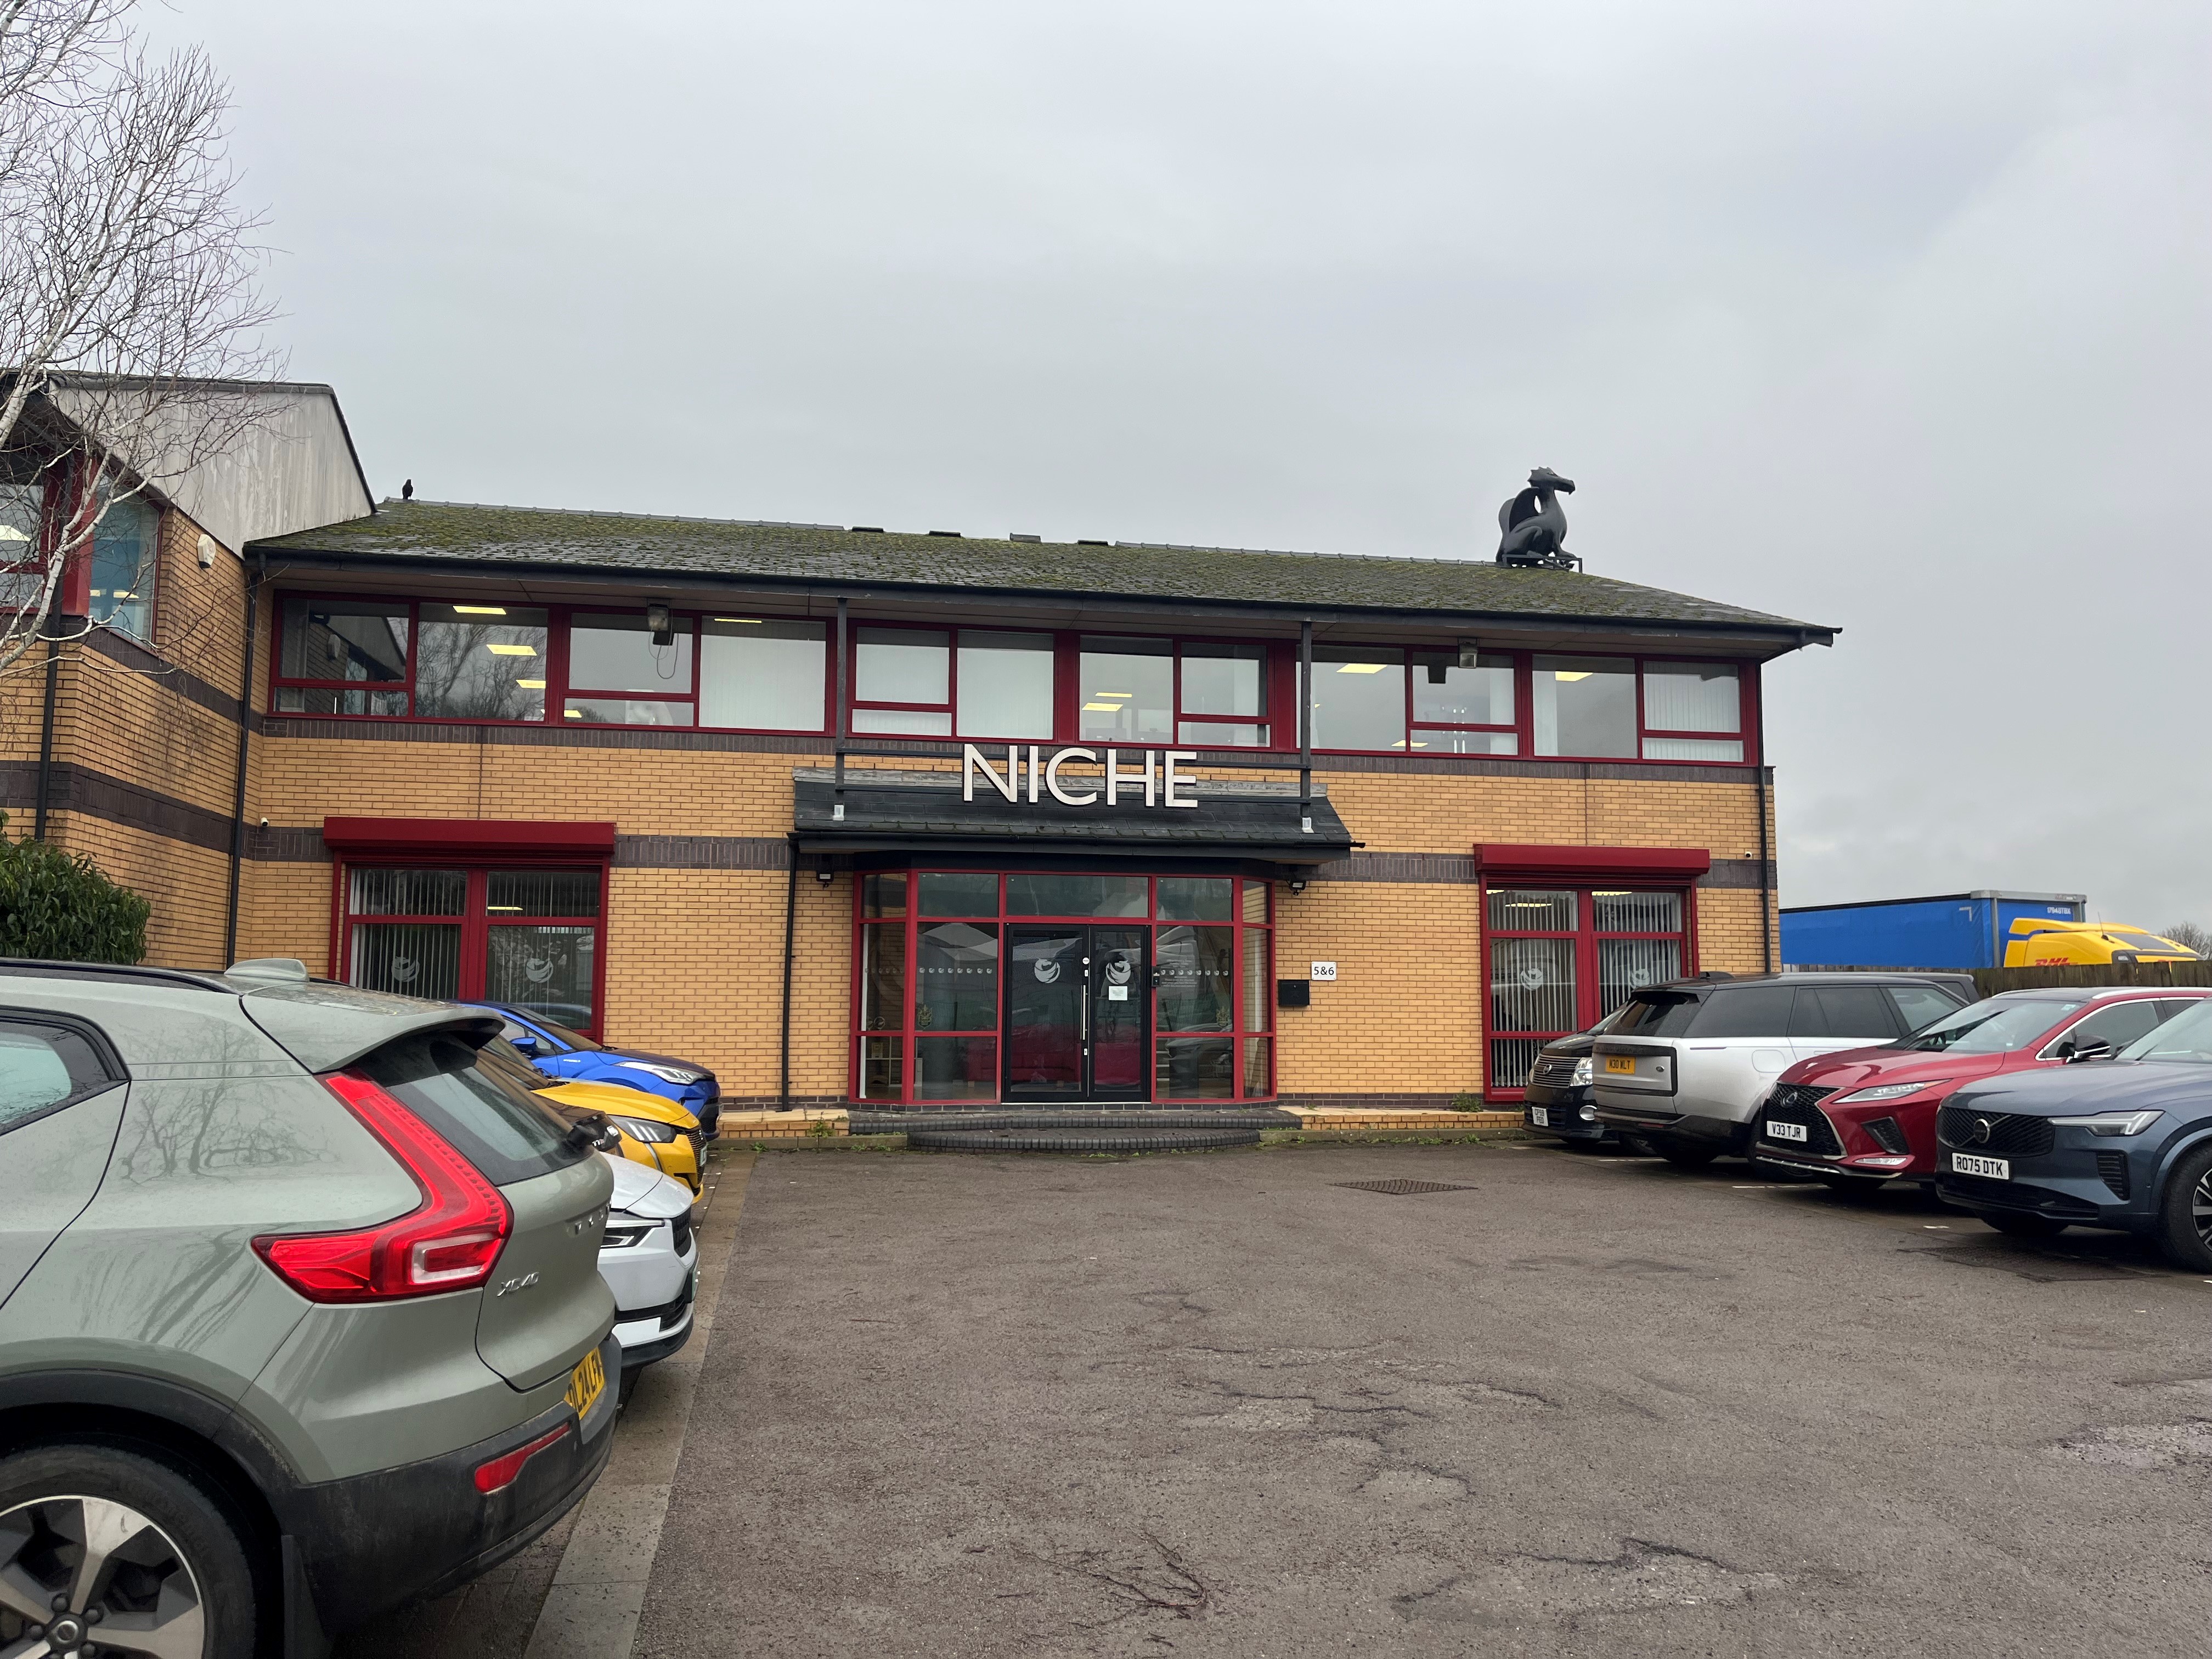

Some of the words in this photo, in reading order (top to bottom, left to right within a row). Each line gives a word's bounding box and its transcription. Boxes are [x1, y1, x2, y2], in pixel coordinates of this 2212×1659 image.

[964, 743, 1198, 808] NICHE
[2035, 957, 2070, 967] DHL
[1314, 967, 1334, 975] 5&6
[1772, 1123, 1785, 1136] V33
[1787, 1125, 1801, 1138] TJR
[1956, 1156, 1980, 1172] RO75
[1983, 1160, 2003, 1176] DTK
[497, 1272, 539, 1296] XC40
